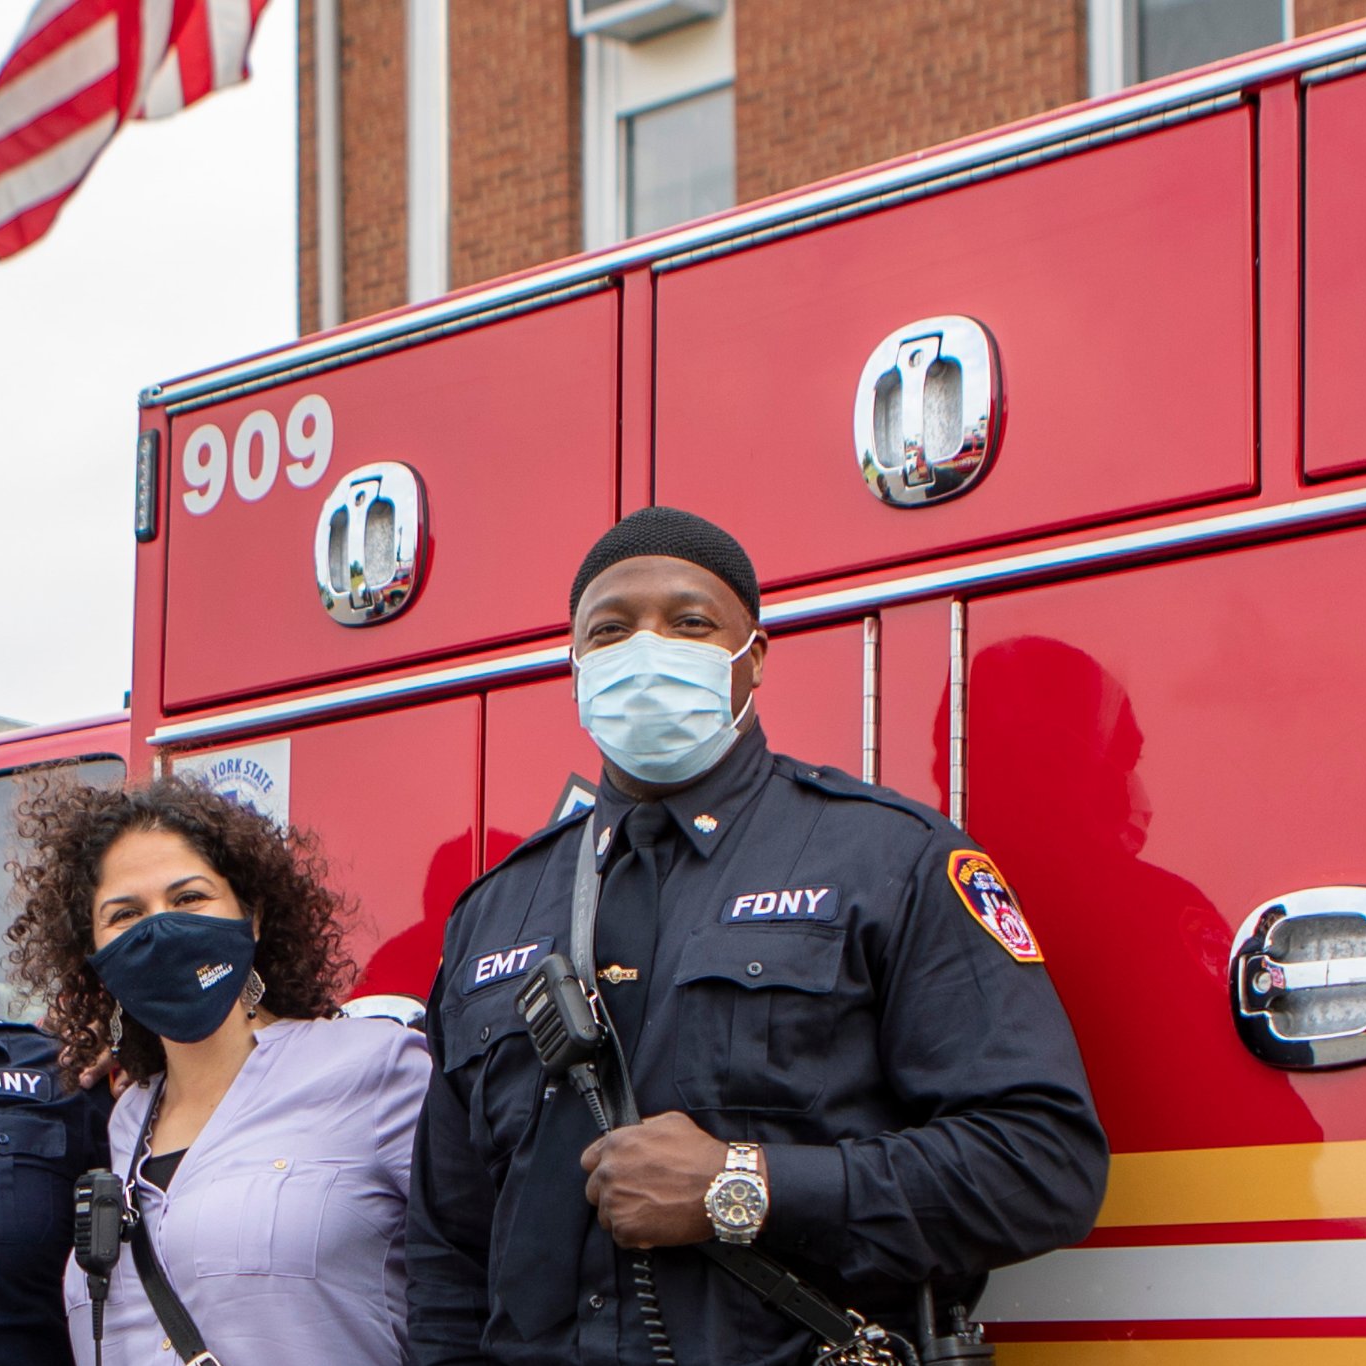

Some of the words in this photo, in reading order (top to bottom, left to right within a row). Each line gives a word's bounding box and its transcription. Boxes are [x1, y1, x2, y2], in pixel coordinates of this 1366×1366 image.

[182, 393, 334, 516] 909
[210, 757, 243, 779] YORK
[243, 759, 275, 795] STATE
[731, 888, 830, 918] FDNY
[474, 944, 538, 985] EMT
